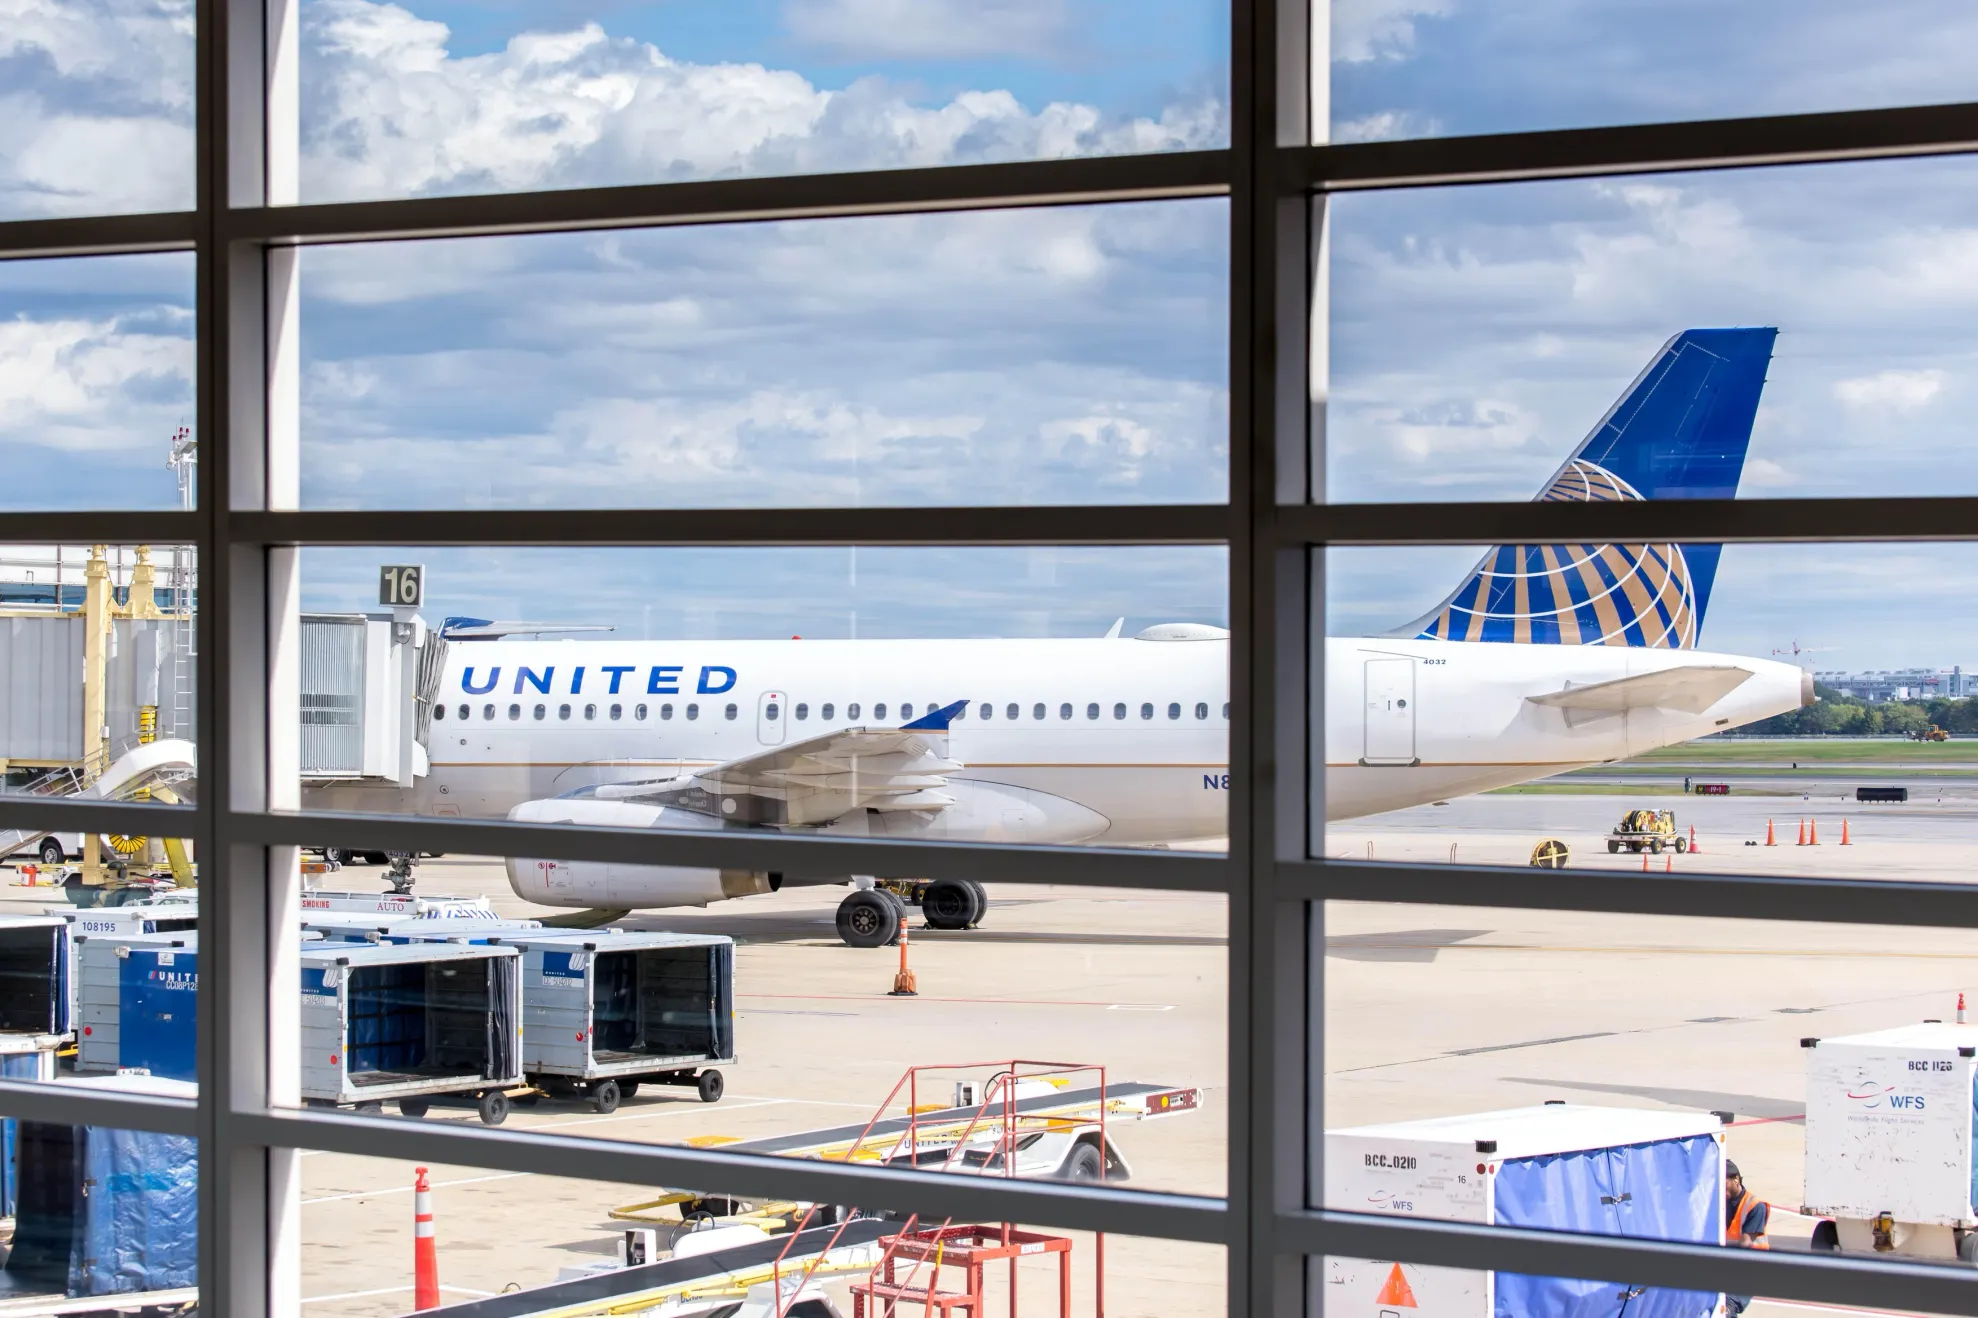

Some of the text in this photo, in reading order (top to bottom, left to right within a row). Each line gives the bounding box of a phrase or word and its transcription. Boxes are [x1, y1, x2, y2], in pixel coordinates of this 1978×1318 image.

[384, 567, 418, 604] 16
[460, 665, 738, 695] UNITED
[302, 899, 330, 909] SMOKING
[377, 901, 405, 912] AUTO
[82, 921, 116, 933] 108195
[1908, 1060, 1929, 1071] BCC
[1890, 1095, 1925, 1110] WFS
[1457, 1175, 1467, 1184] 16
[1392, 1200, 1413, 1211] WFS
